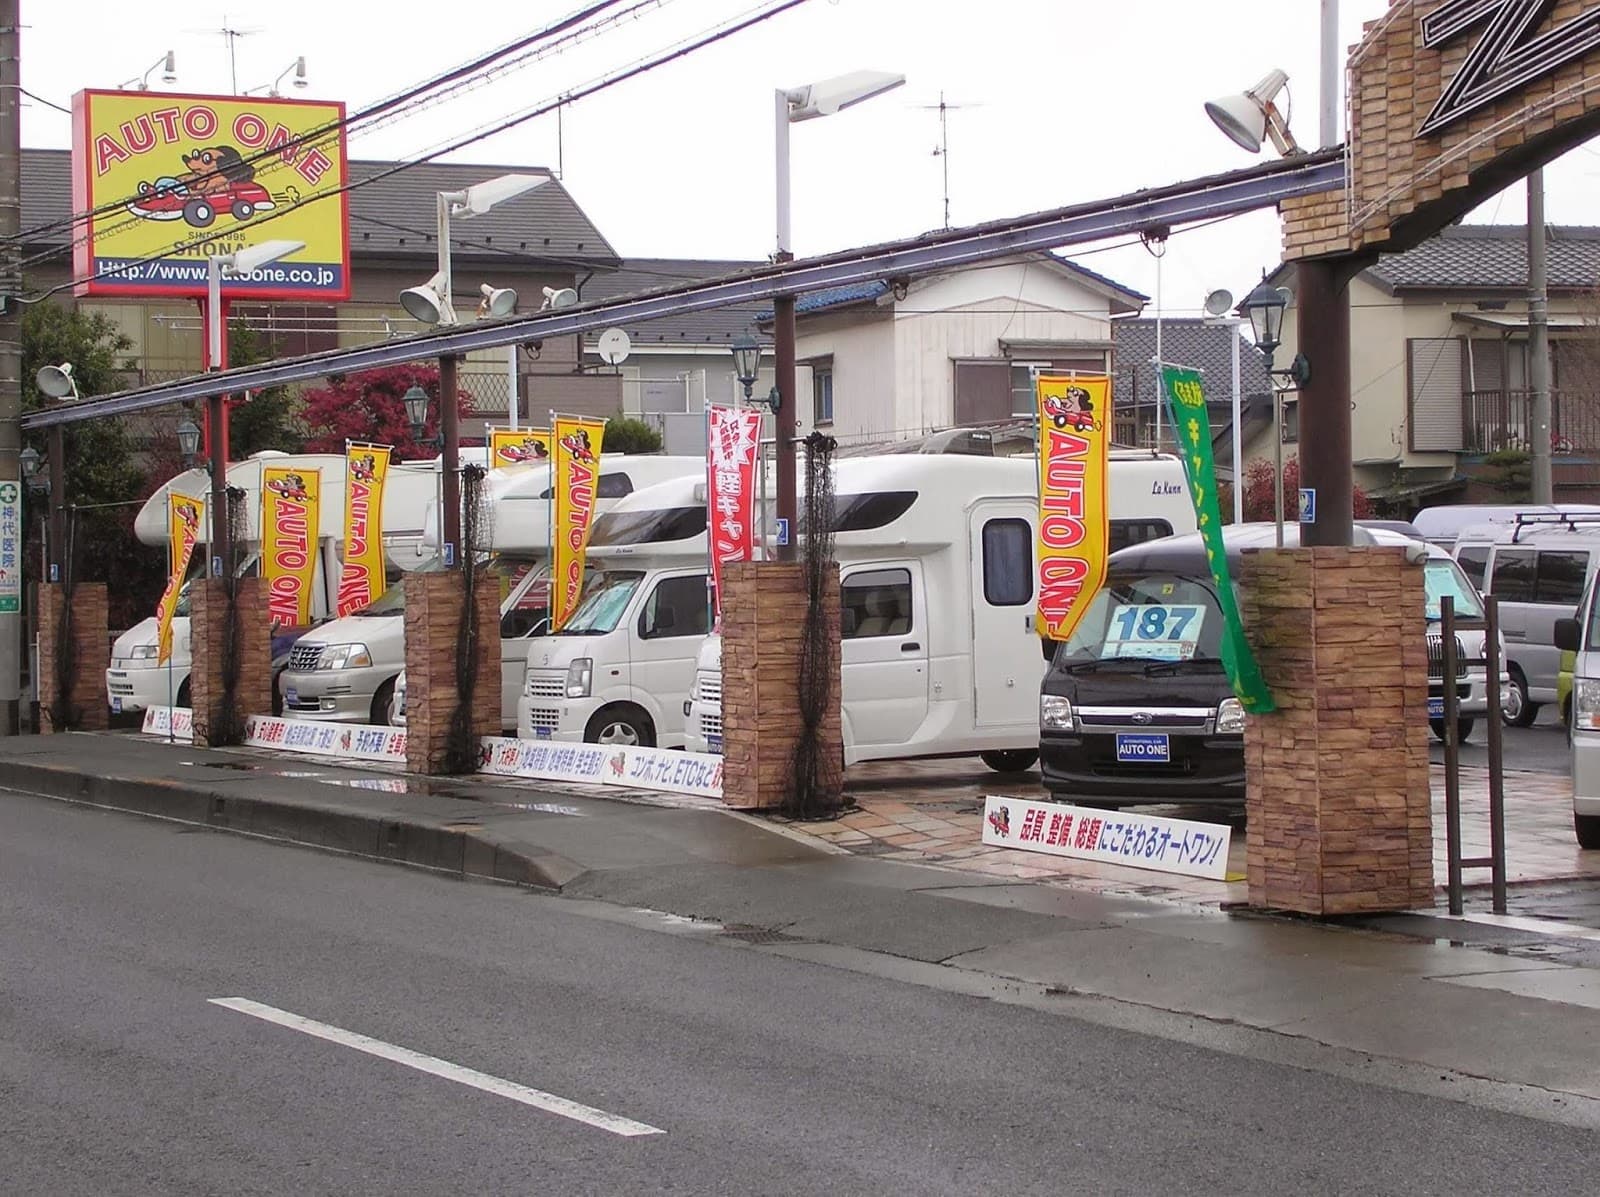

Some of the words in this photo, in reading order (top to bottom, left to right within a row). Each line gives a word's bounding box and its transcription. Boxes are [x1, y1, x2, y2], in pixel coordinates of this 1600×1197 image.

[95, 105, 218, 176] AUTO
[232, 112, 334, 186] ONE
[173, 241, 257, 258] SHONA
[347, 482, 370, 559] AUTO
[567, 461, 594, 552] AUTO
[1041, 428, 1091, 549] AUTO
[274, 499, 309, 572] AUTO
[1116, 606, 1197, 641] 187
[1119, 744, 1145, 754] AUTO
[1146, 744, 1167, 755] ONE
